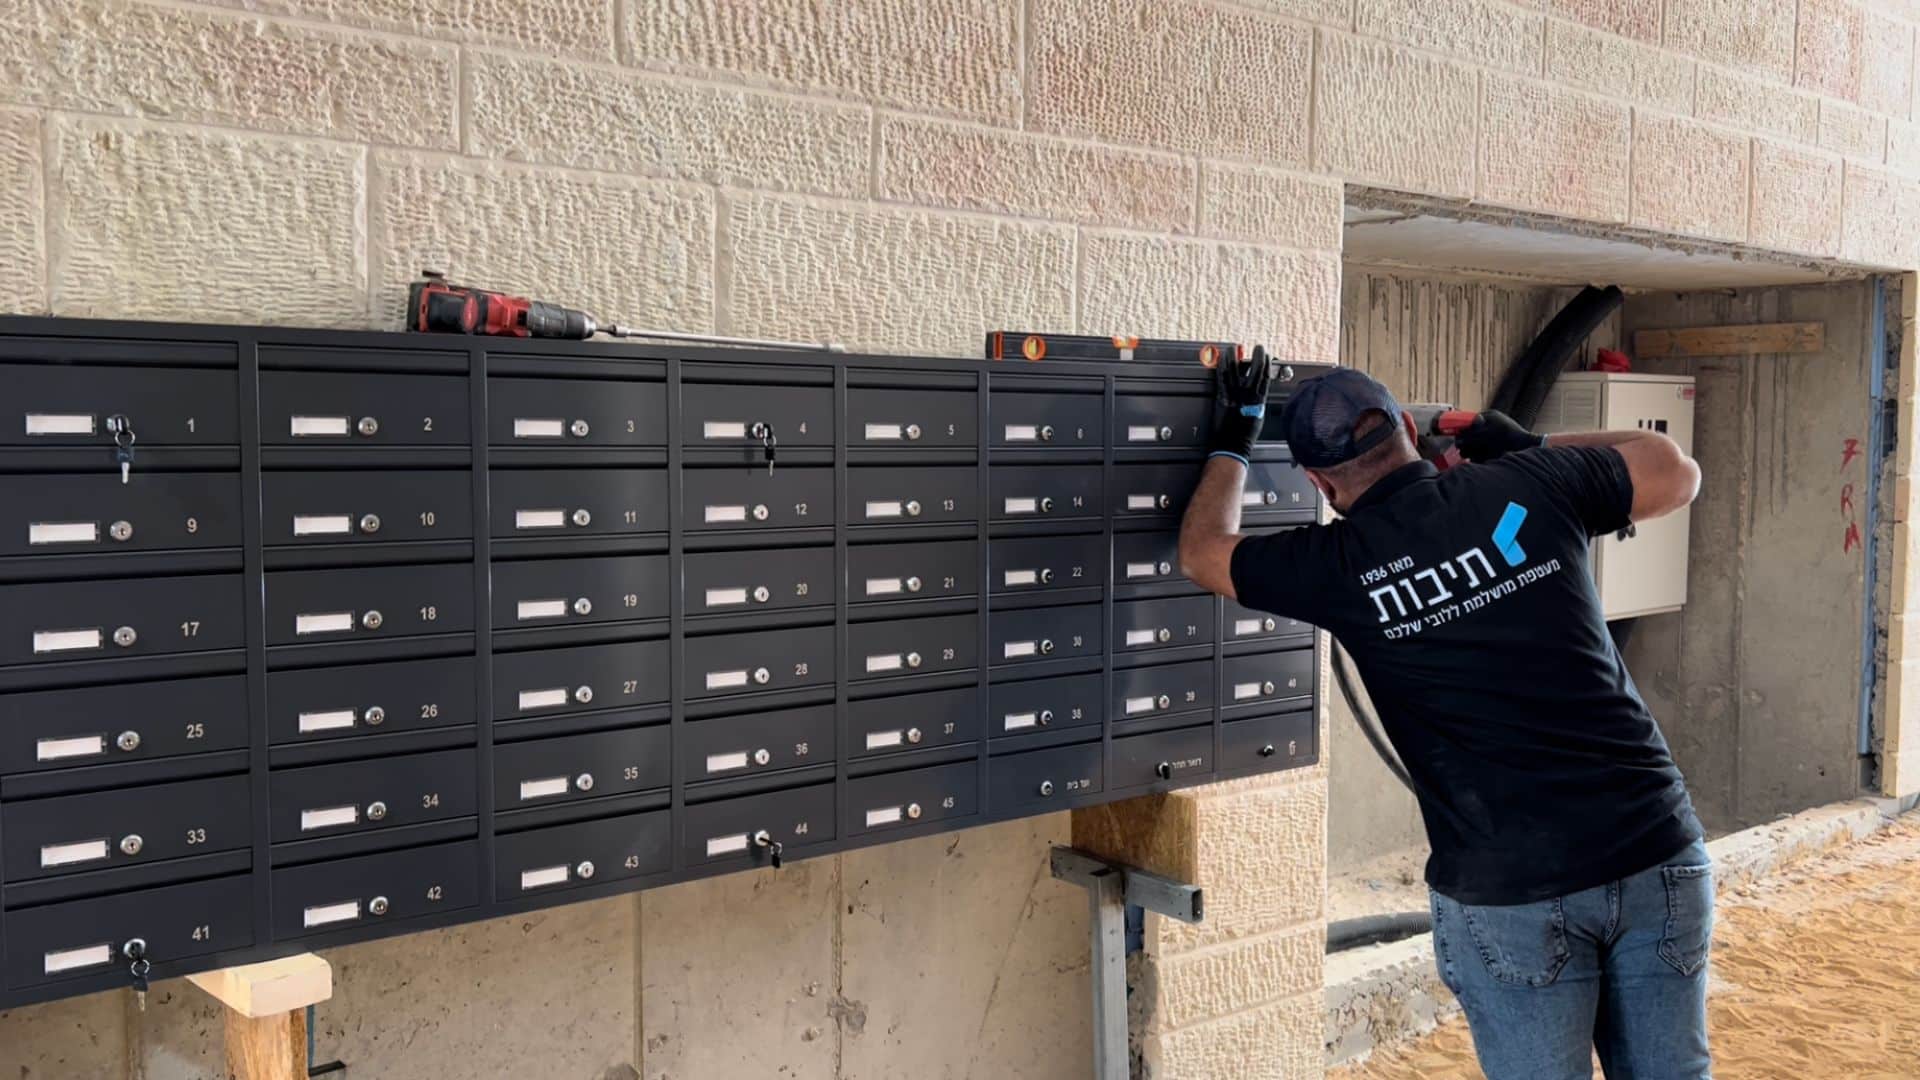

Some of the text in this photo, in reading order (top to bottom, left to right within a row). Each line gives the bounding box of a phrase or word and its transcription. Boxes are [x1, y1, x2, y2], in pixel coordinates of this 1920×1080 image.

[187, 418, 195, 433] 1
[423, 417, 432, 431] 2
[627, 420, 635, 433] 3
[799, 422, 807, 433] 4
[948, 424, 955, 436] 5
[943, 499, 954, 511] 13
[1073, 495, 1083, 507] 14
[795, 503, 807, 515] 12
[420, 511, 435, 526] 10
[624, 511, 636, 523] 11
[187, 517, 197, 533] 9
[1072, 566, 1082, 577] 22
[1360, 555, 1415, 585] מאז 1936
[796, 583, 808, 596] 20
[943, 577, 954, 589] 21
[1368, 547, 1497, 623] תיבות
[623, 594, 638, 607] 19
[1384, 558, 1561, 640] מעטפת מושלמת ללובי שלכם
[420, 606, 437, 620] 18
[181, 621, 200, 637] 17
[1187, 625, 1196, 636] 31
[1073, 635, 1082, 647] 30
[943, 648, 954, 660] 29
[795, 663, 808, 676] 28
[623, 680, 638, 694] 27
[1288, 678, 1297, 688] 40
[421, 703, 438, 719] 26
[186, 723, 204, 739] 25
[944, 722, 954, 734] 37
[795, 742, 808, 755] 36
[624, 766, 638, 780] 35
[423, 793, 439, 809] 34
[942, 796, 954, 808] 45
[795, 822, 808, 835] 44
[187, 828, 206, 844] 33
[624, 855, 639, 868] 43
[427, 885, 442, 900] 42
[192, 925, 209, 941] 41
